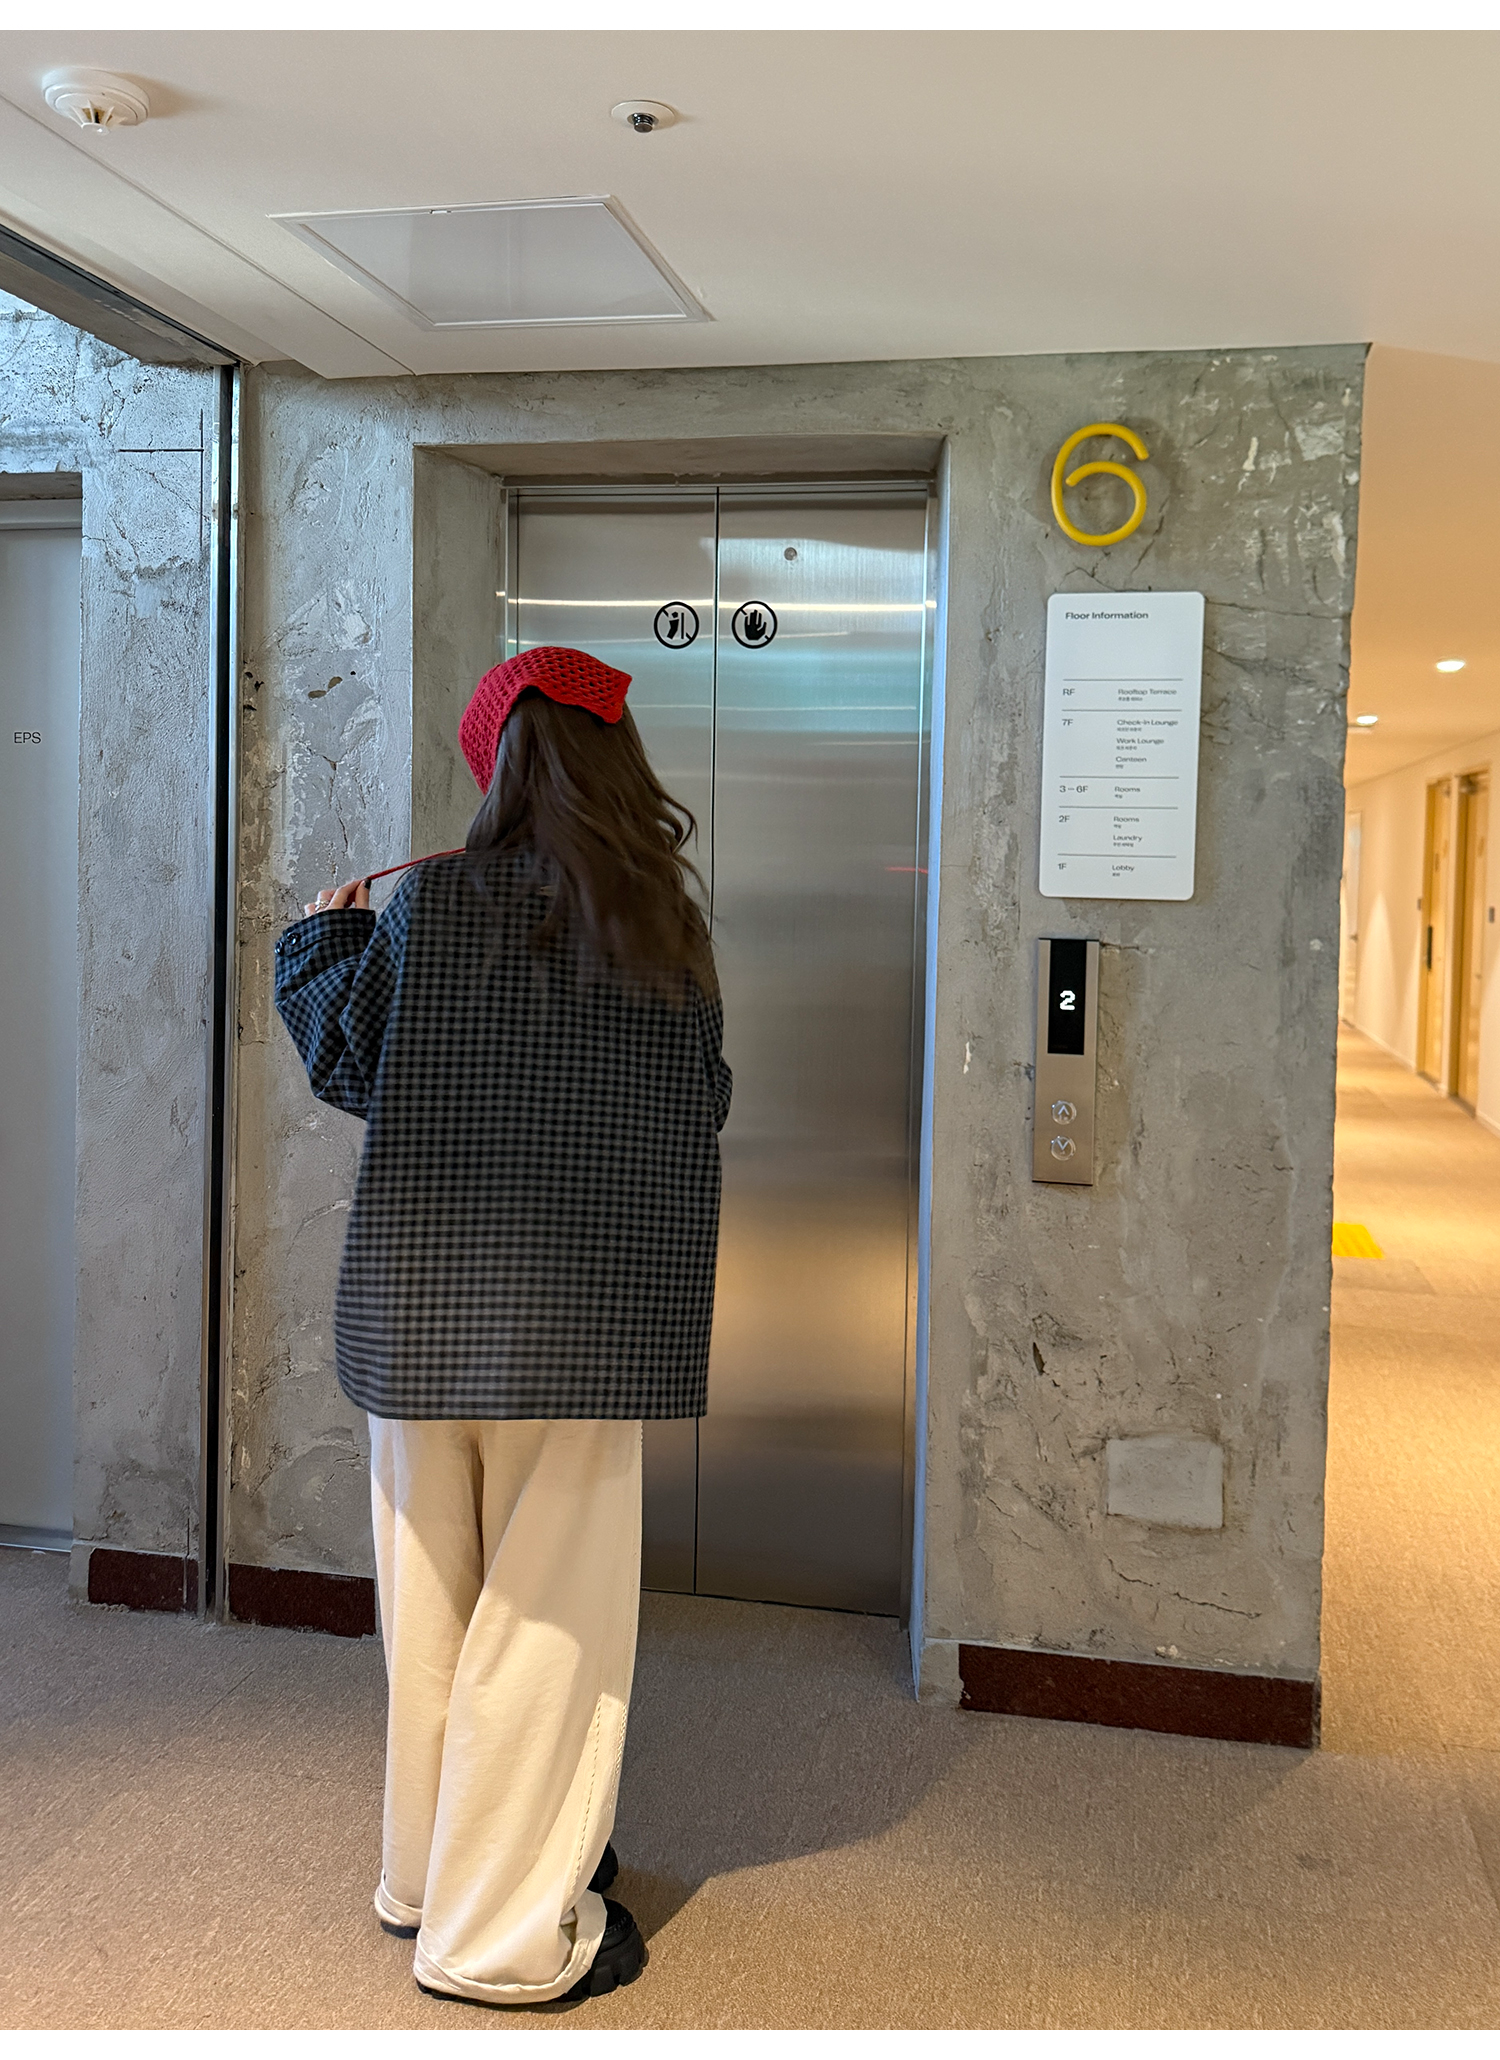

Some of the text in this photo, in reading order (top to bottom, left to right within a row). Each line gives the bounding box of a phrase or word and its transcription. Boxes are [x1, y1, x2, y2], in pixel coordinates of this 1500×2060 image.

[1051, 423, 1149, 546] 6
[1065, 611, 1149, 620] Floor Information
[1062, 688, 1076, 696] RF
[1118, 688, 1177, 696] Rooftop Terrace
[1151, 719, 1179, 727] Lounge
[14, 731, 42, 744] EPS
[1113, 834, 1143, 842] Laundry
[1057, 862, 1067, 870] 1F
[1112, 864, 1135, 872] Lobby
[1059, 989, 1076, 1011] 2
